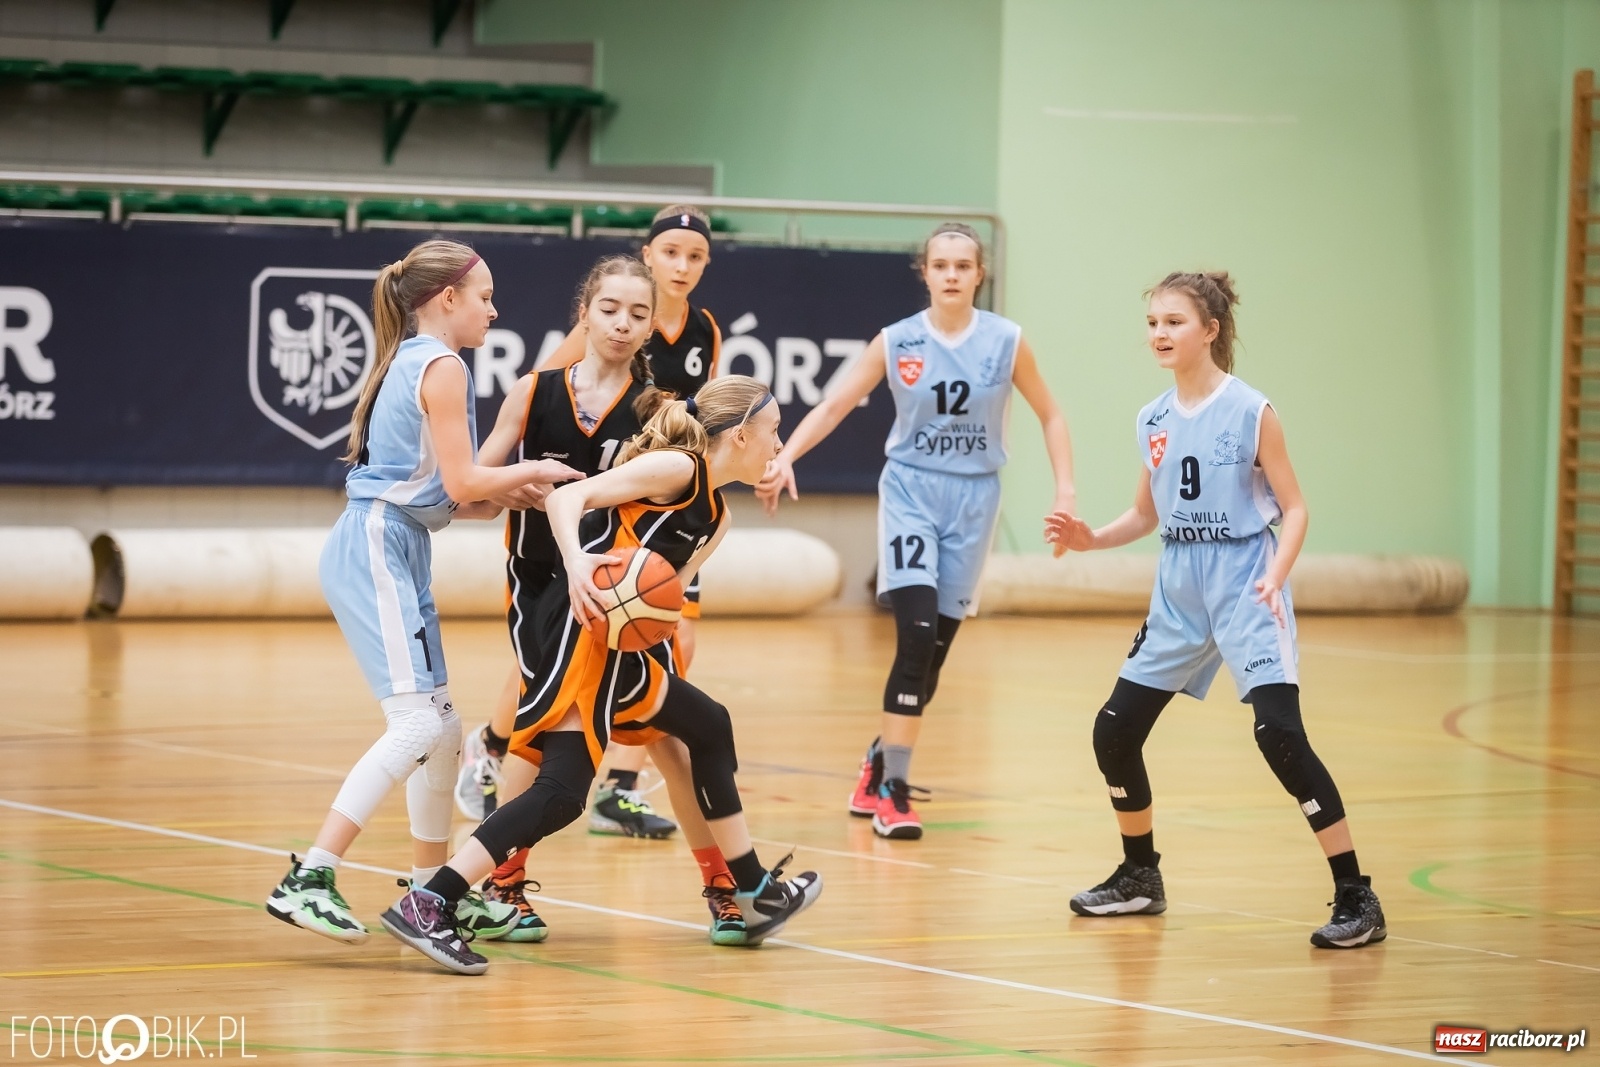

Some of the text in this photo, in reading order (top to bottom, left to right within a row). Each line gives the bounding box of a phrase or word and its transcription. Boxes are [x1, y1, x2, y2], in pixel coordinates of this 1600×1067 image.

[684, 347, 703, 377] 6
[931, 379, 971, 416] 12
[951, 424, 987, 434] WILLA
[915, 432, 987, 456] Cyprys
[1179, 455, 1201, 501] 9
[1191, 511, 1229, 524] WILLA
[1161, 524, 1231, 542] yprys
[889, 535, 926, 570] 12
[414, 627, 432, 673] 1
[1249, 657, 1274, 670] IBRA
